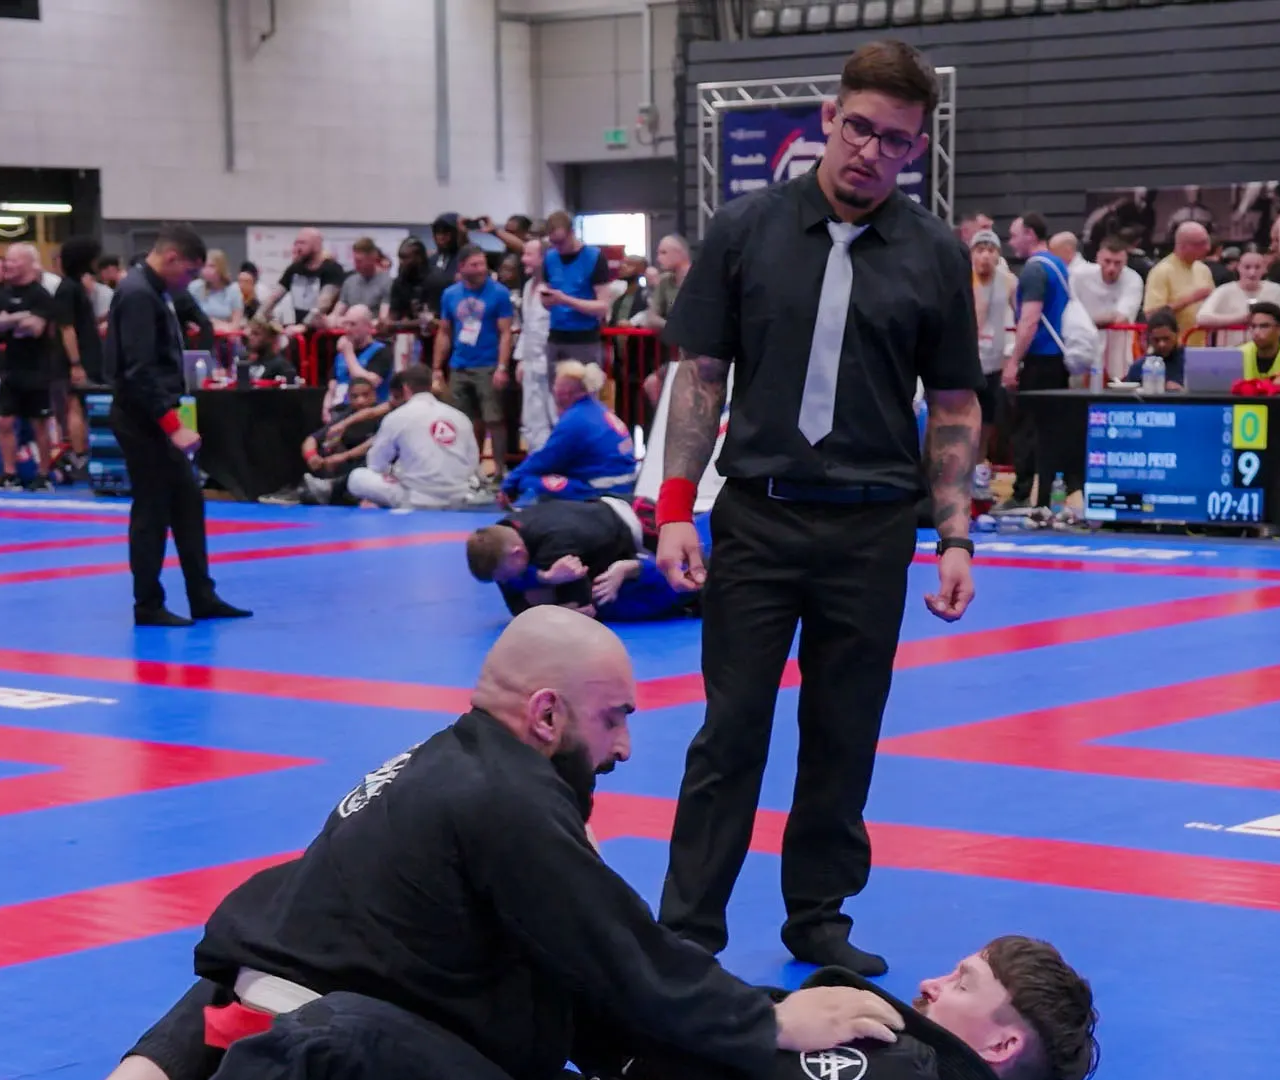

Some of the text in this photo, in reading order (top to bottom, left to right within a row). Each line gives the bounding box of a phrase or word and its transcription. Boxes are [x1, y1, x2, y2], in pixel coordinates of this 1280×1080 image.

[1108, 411, 1135, 427] CHRIS
[1240, 411, 1260, 443] 0
[1107, 451, 1147, 468] RICHARD
[1237, 451, 1261, 487] 9
[1207, 491, 1260, 516] 02:41
